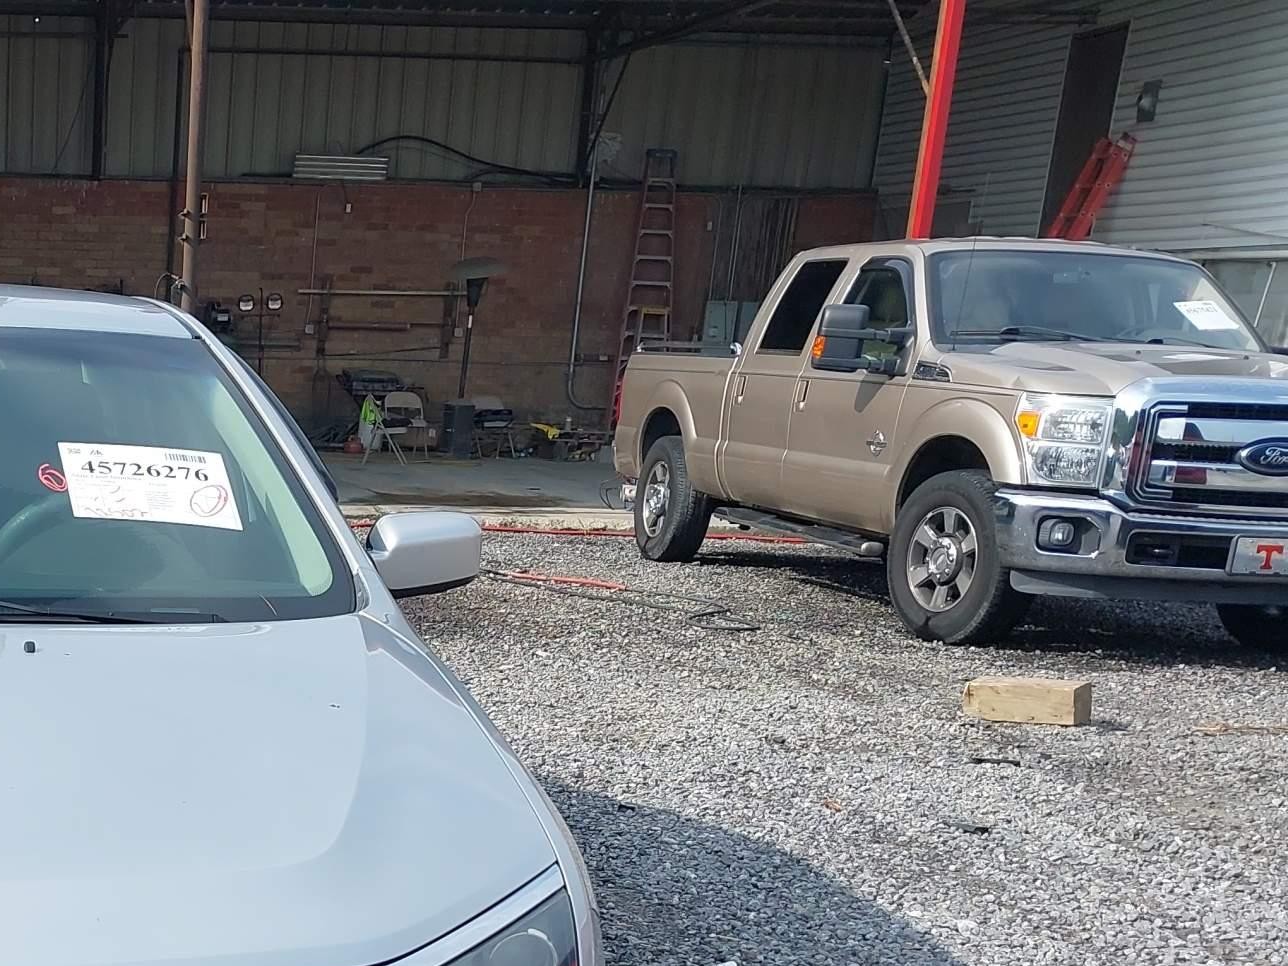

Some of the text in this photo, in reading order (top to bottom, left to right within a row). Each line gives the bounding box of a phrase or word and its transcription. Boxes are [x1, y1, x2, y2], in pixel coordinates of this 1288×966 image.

[1260, 446, 1288, 465] For
[81, 460, 209, 482] 45726276
[1256, 544, 1285, 570] T
